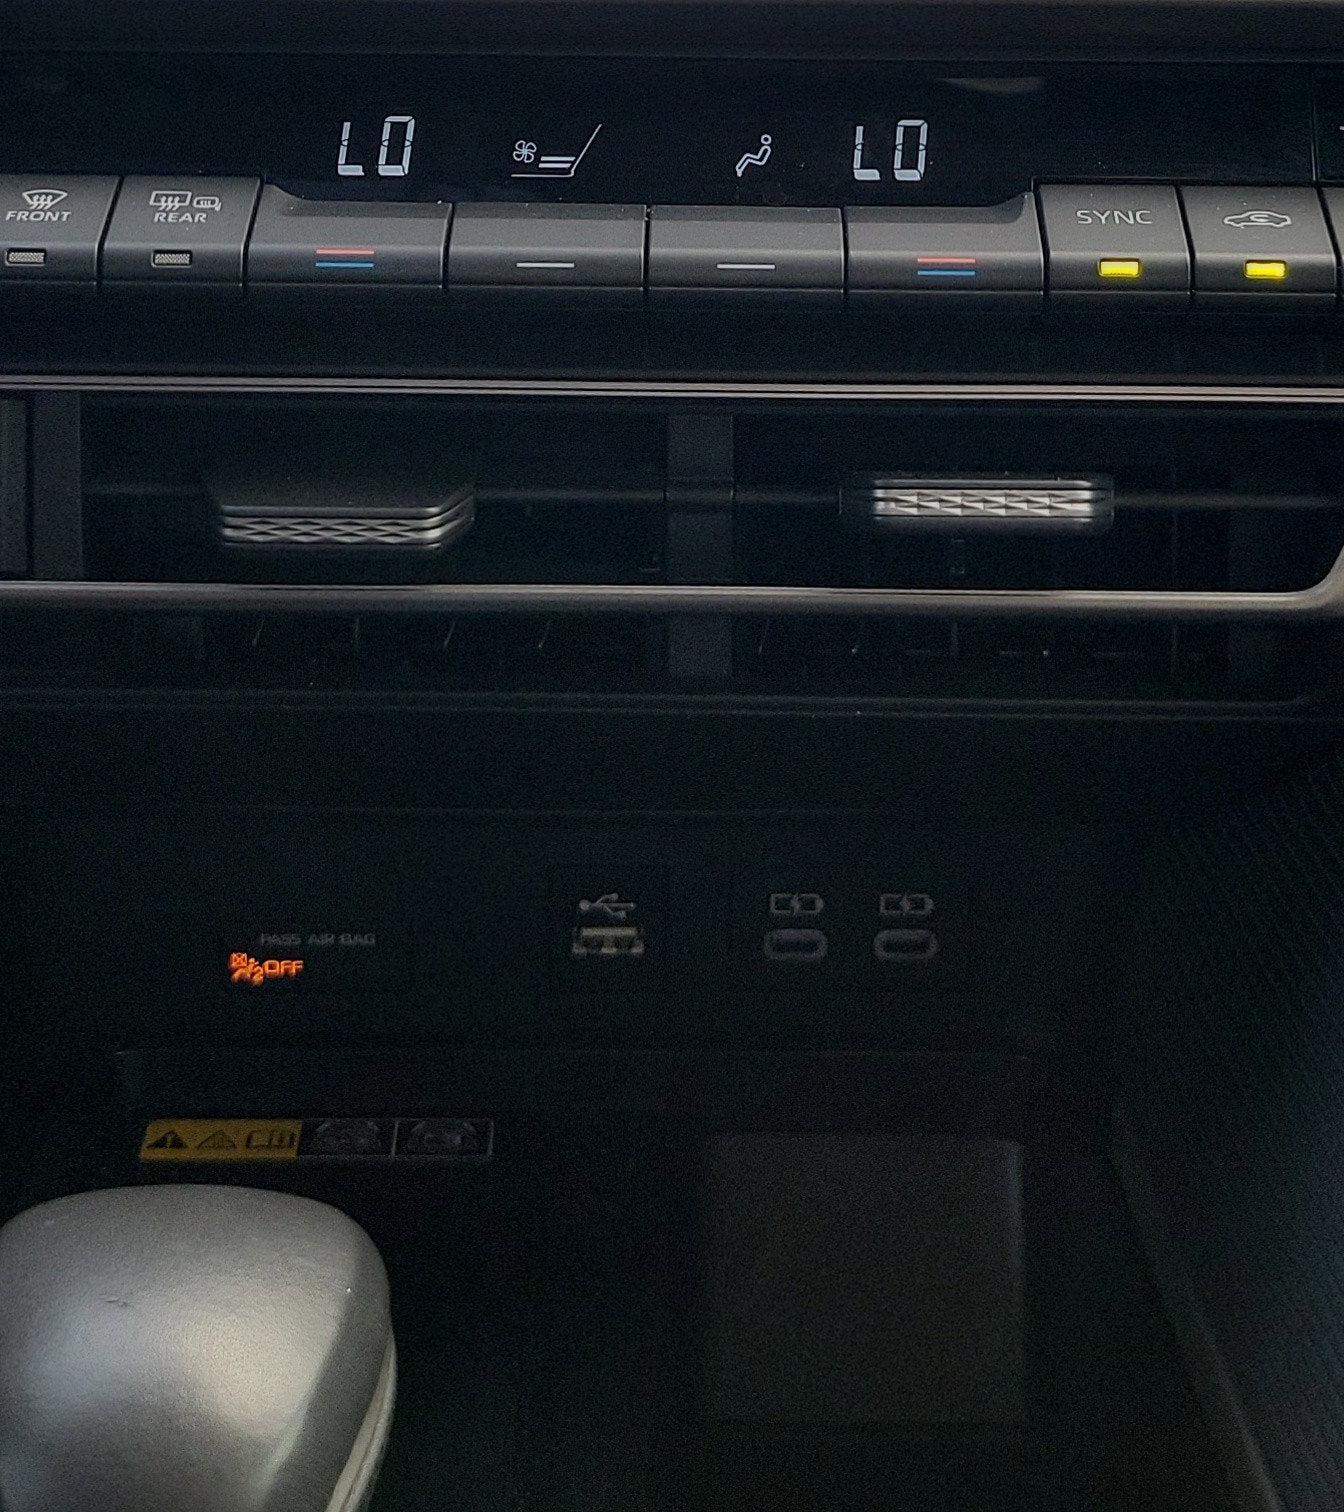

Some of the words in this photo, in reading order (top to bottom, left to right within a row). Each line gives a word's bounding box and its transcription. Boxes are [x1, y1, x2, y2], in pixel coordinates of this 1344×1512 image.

[5, 210, 72, 222] FRONT
[154, 213, 207, 223] REAR
[1076, 210, 1153, 225] SYNC
[263, 959, 304, 977] OFF
